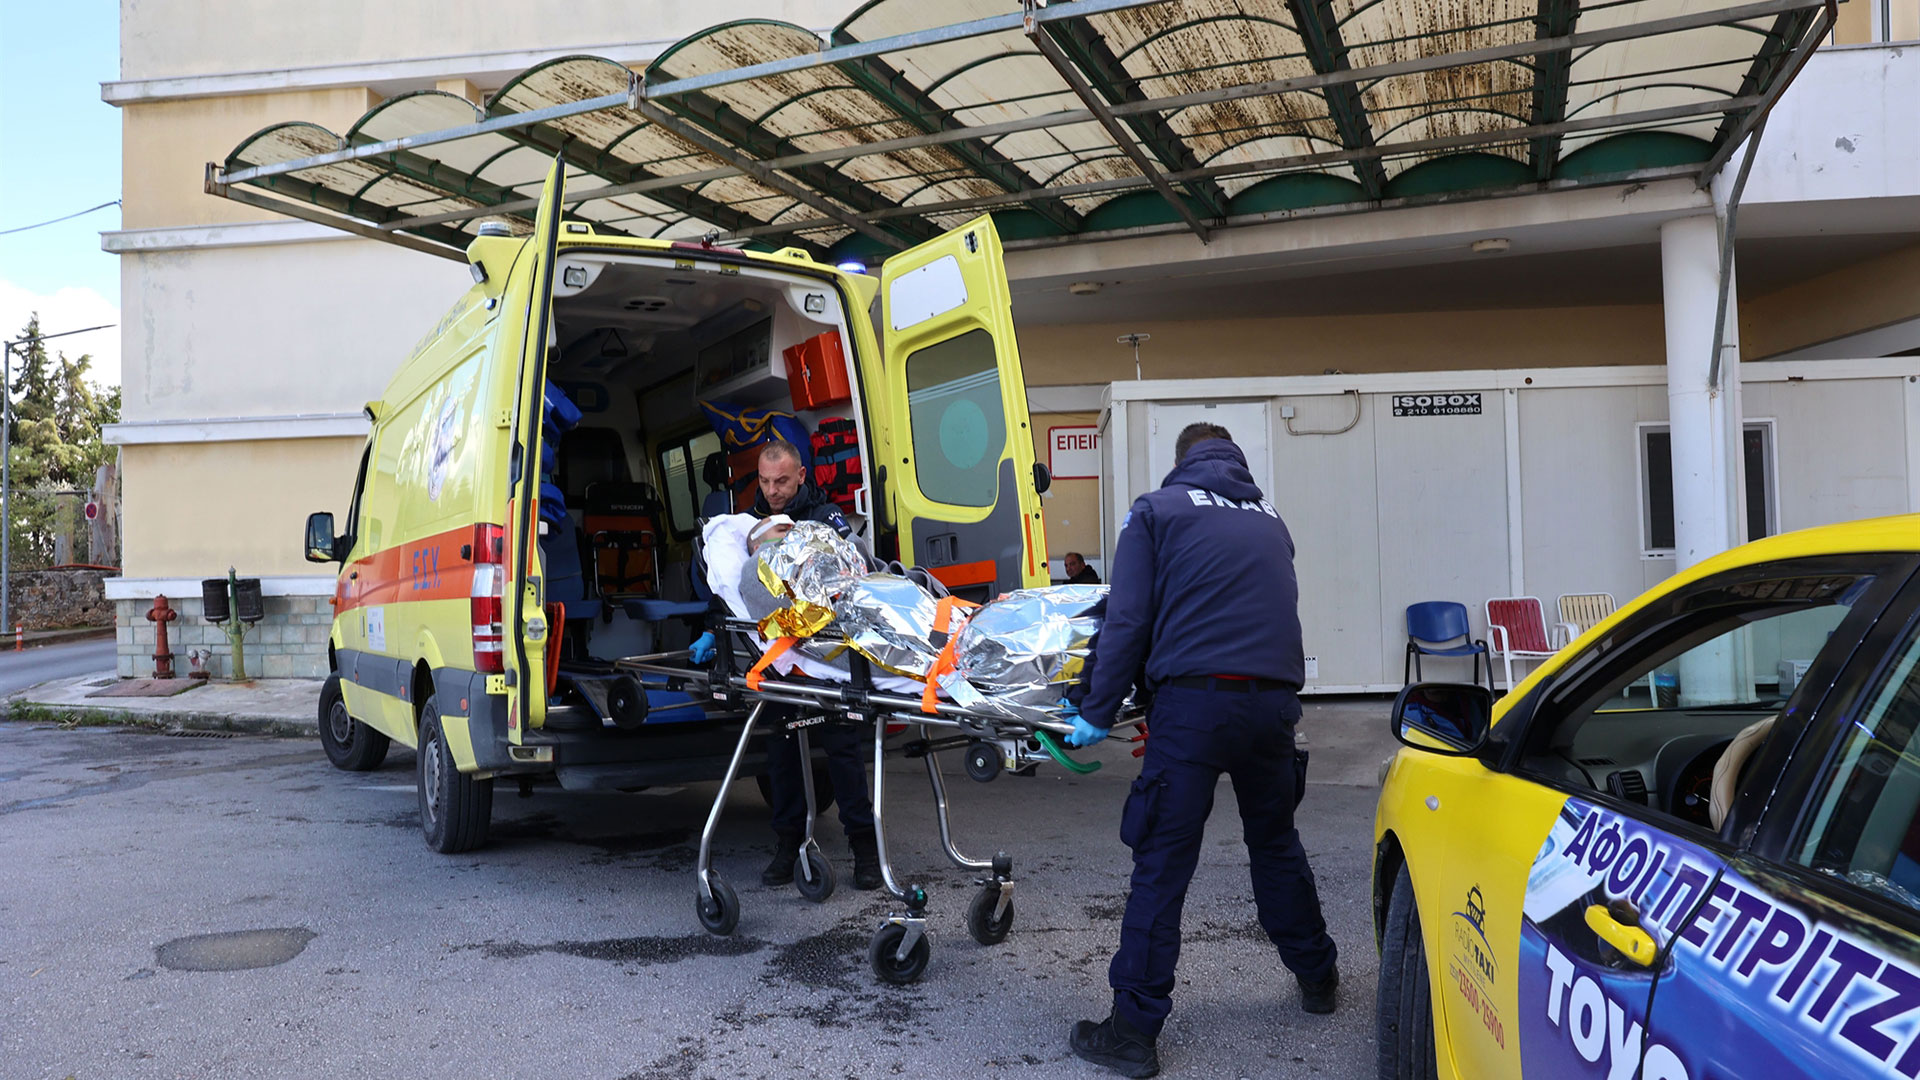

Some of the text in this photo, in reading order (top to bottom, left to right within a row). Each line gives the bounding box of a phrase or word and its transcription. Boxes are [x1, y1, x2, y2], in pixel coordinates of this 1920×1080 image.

[1393, 394, 1480, 408] ISOBOX
[1433, 407, 1481, 415] 6108880
[787, 715, 826, 730] SPENCER
[1562, 811, 1920, 1080] ΑΦΟΙ ΠΕΤΡΙΤΖ
[1481, 998, 1505, 1050] 25900
